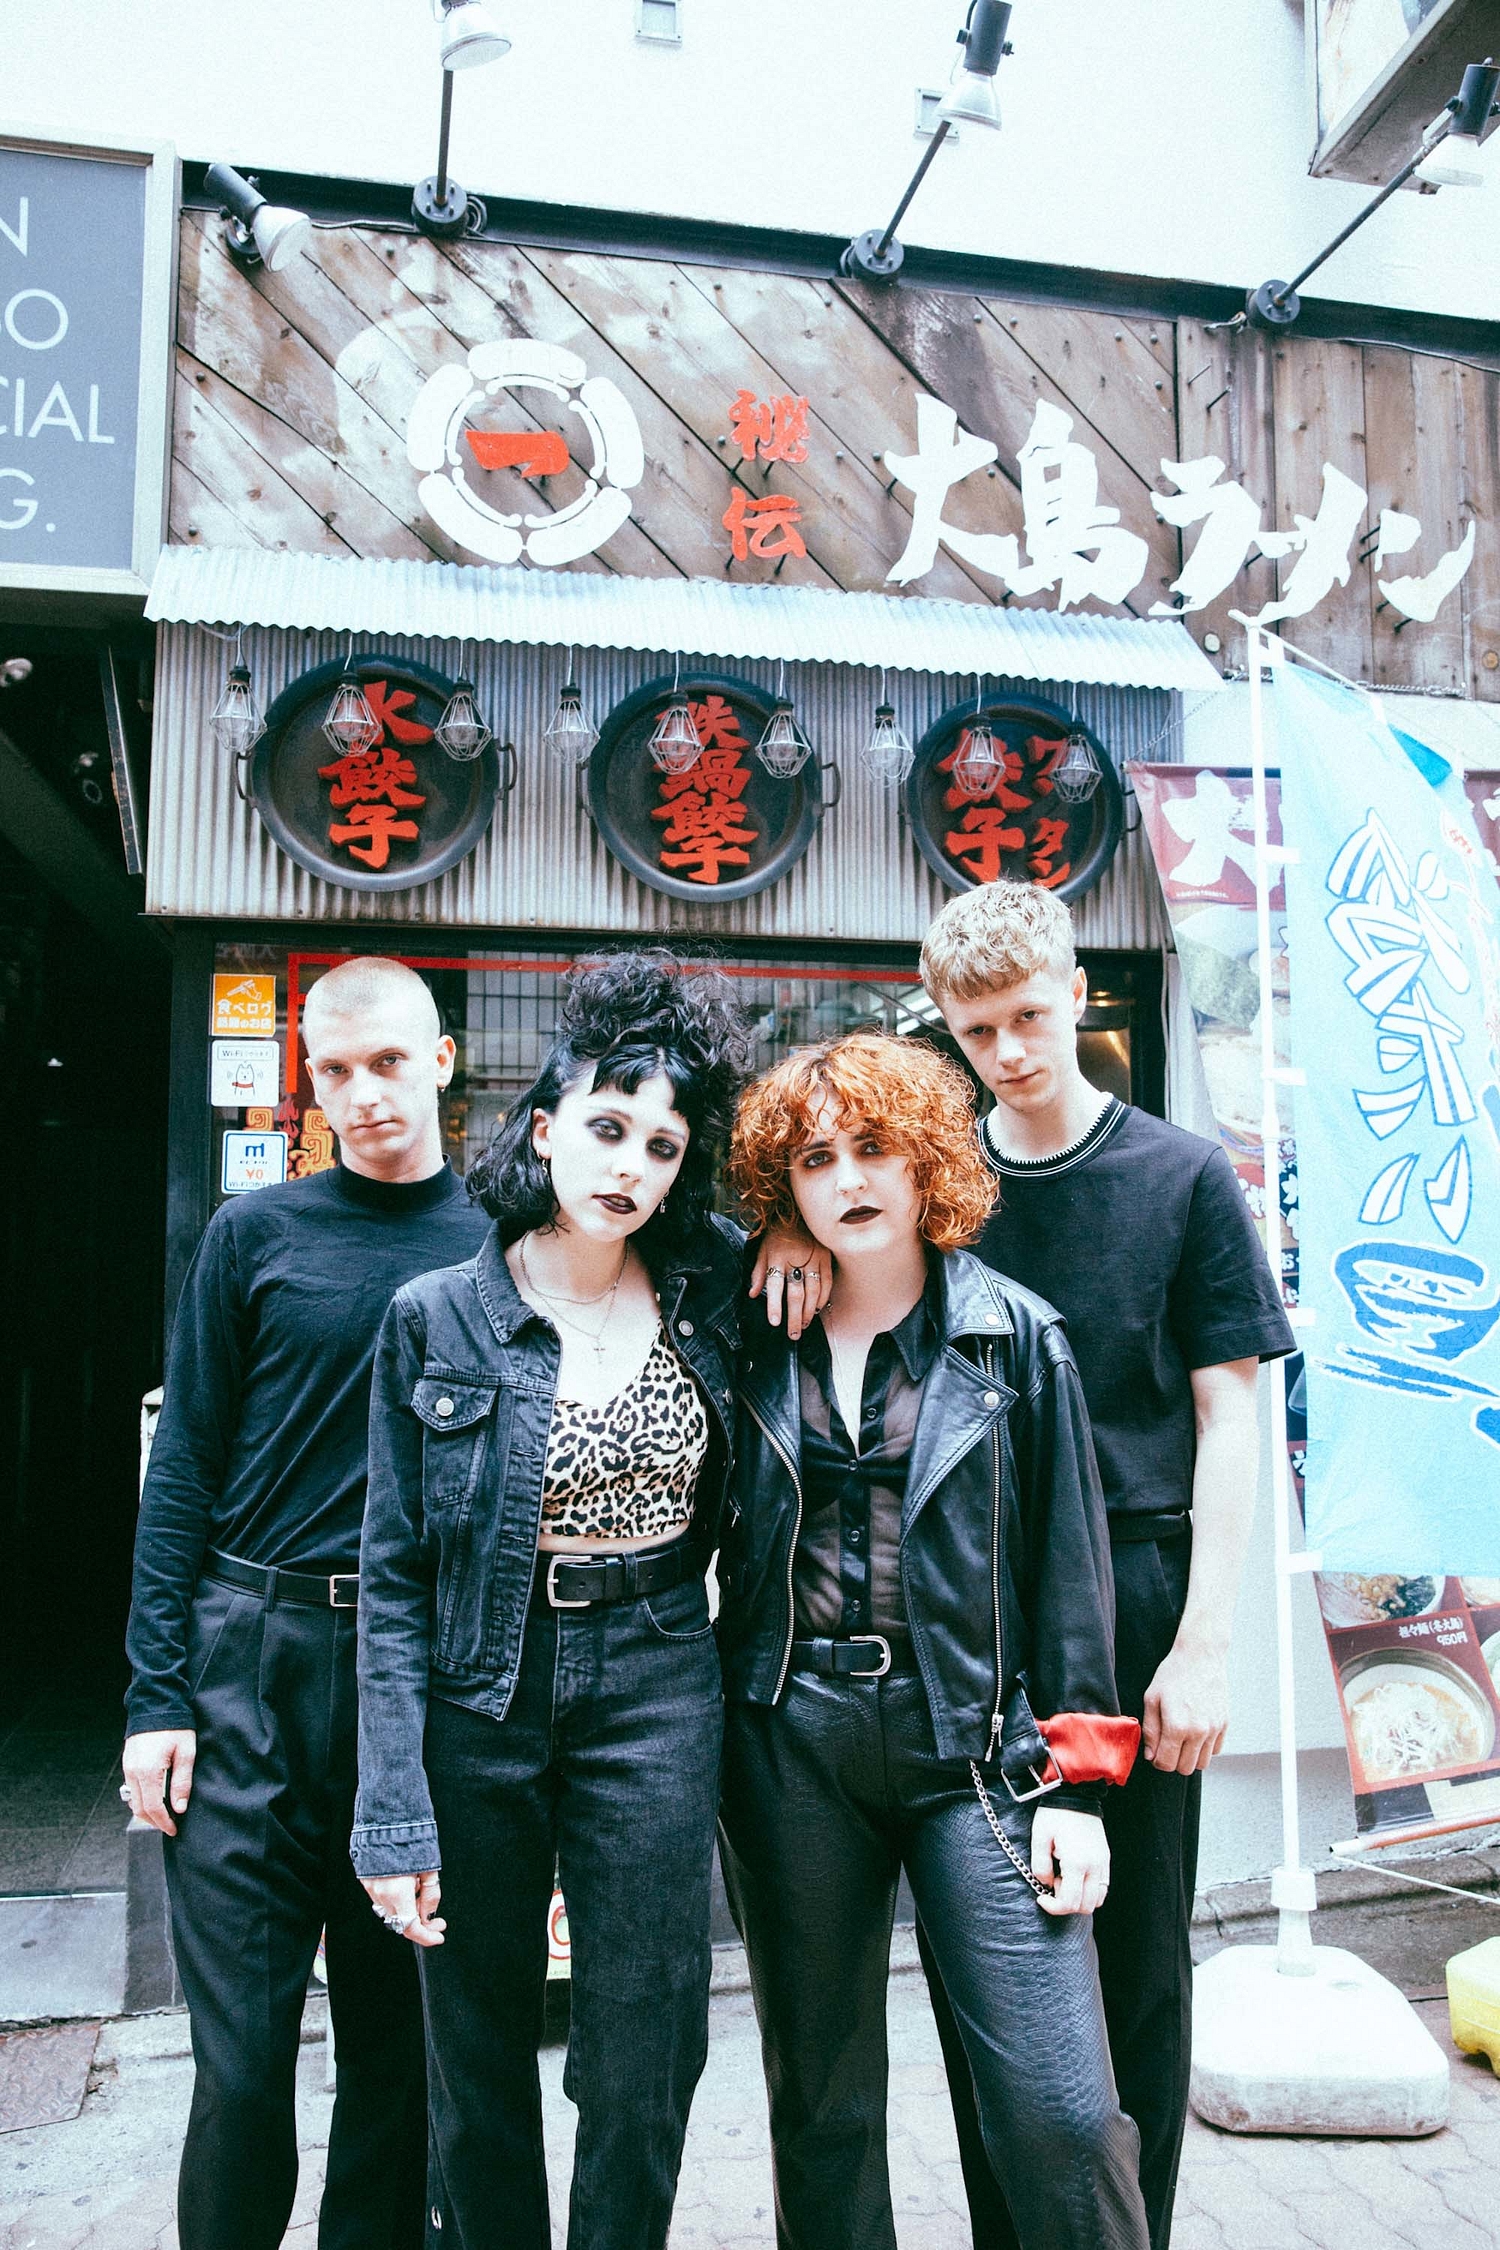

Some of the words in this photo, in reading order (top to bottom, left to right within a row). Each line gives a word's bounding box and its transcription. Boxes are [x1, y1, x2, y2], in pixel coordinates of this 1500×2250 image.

[884, 393, 1475, 622] 大島ラーメン
[217, 999, 272, 1016] 食べログ
[1436, 1631, 1468, 1646] 950円
